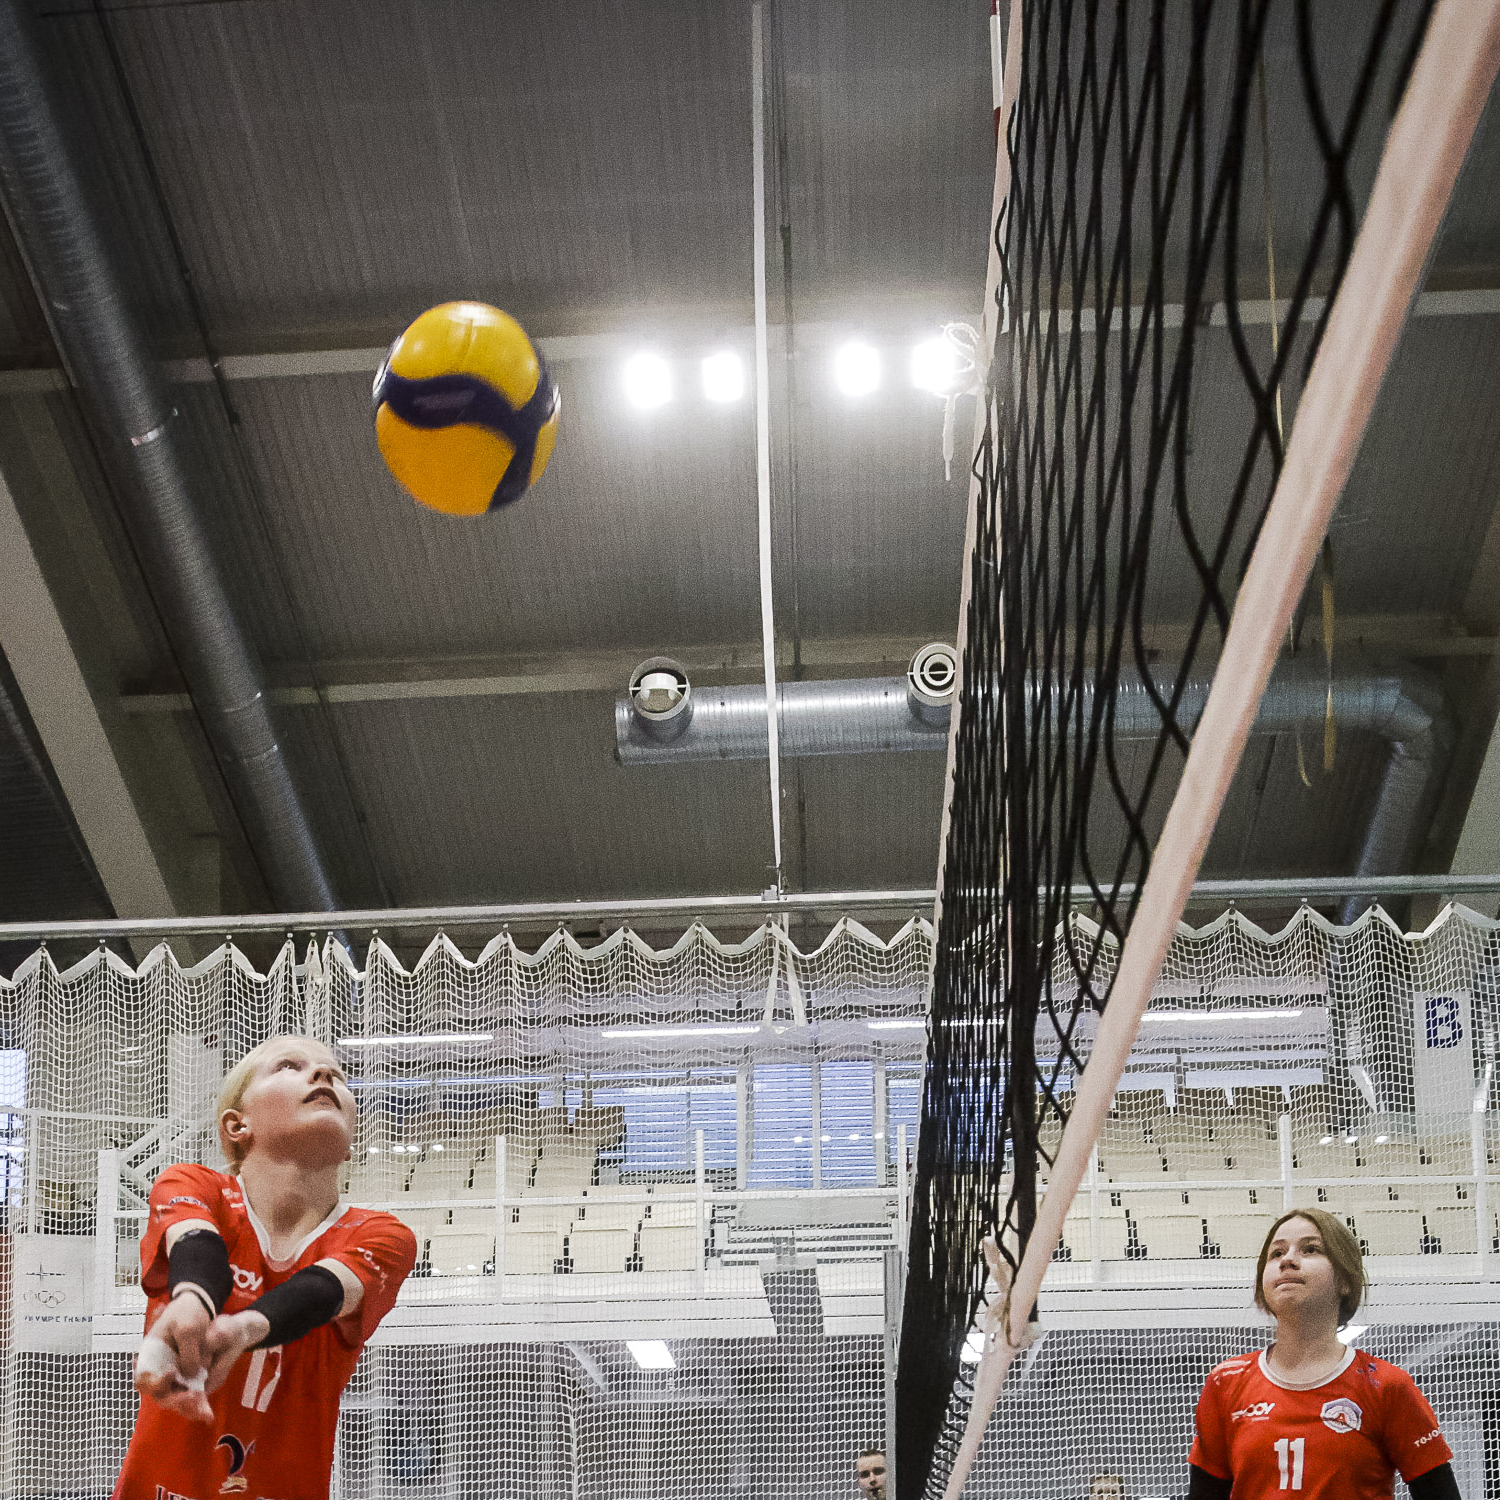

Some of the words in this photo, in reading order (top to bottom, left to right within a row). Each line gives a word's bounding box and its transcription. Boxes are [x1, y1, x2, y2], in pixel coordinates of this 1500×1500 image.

[1425, 996, 1463, 1049] B
[241, 1345, 283, 1413] 17
[1274, 1437, 1306, 1490] 11
